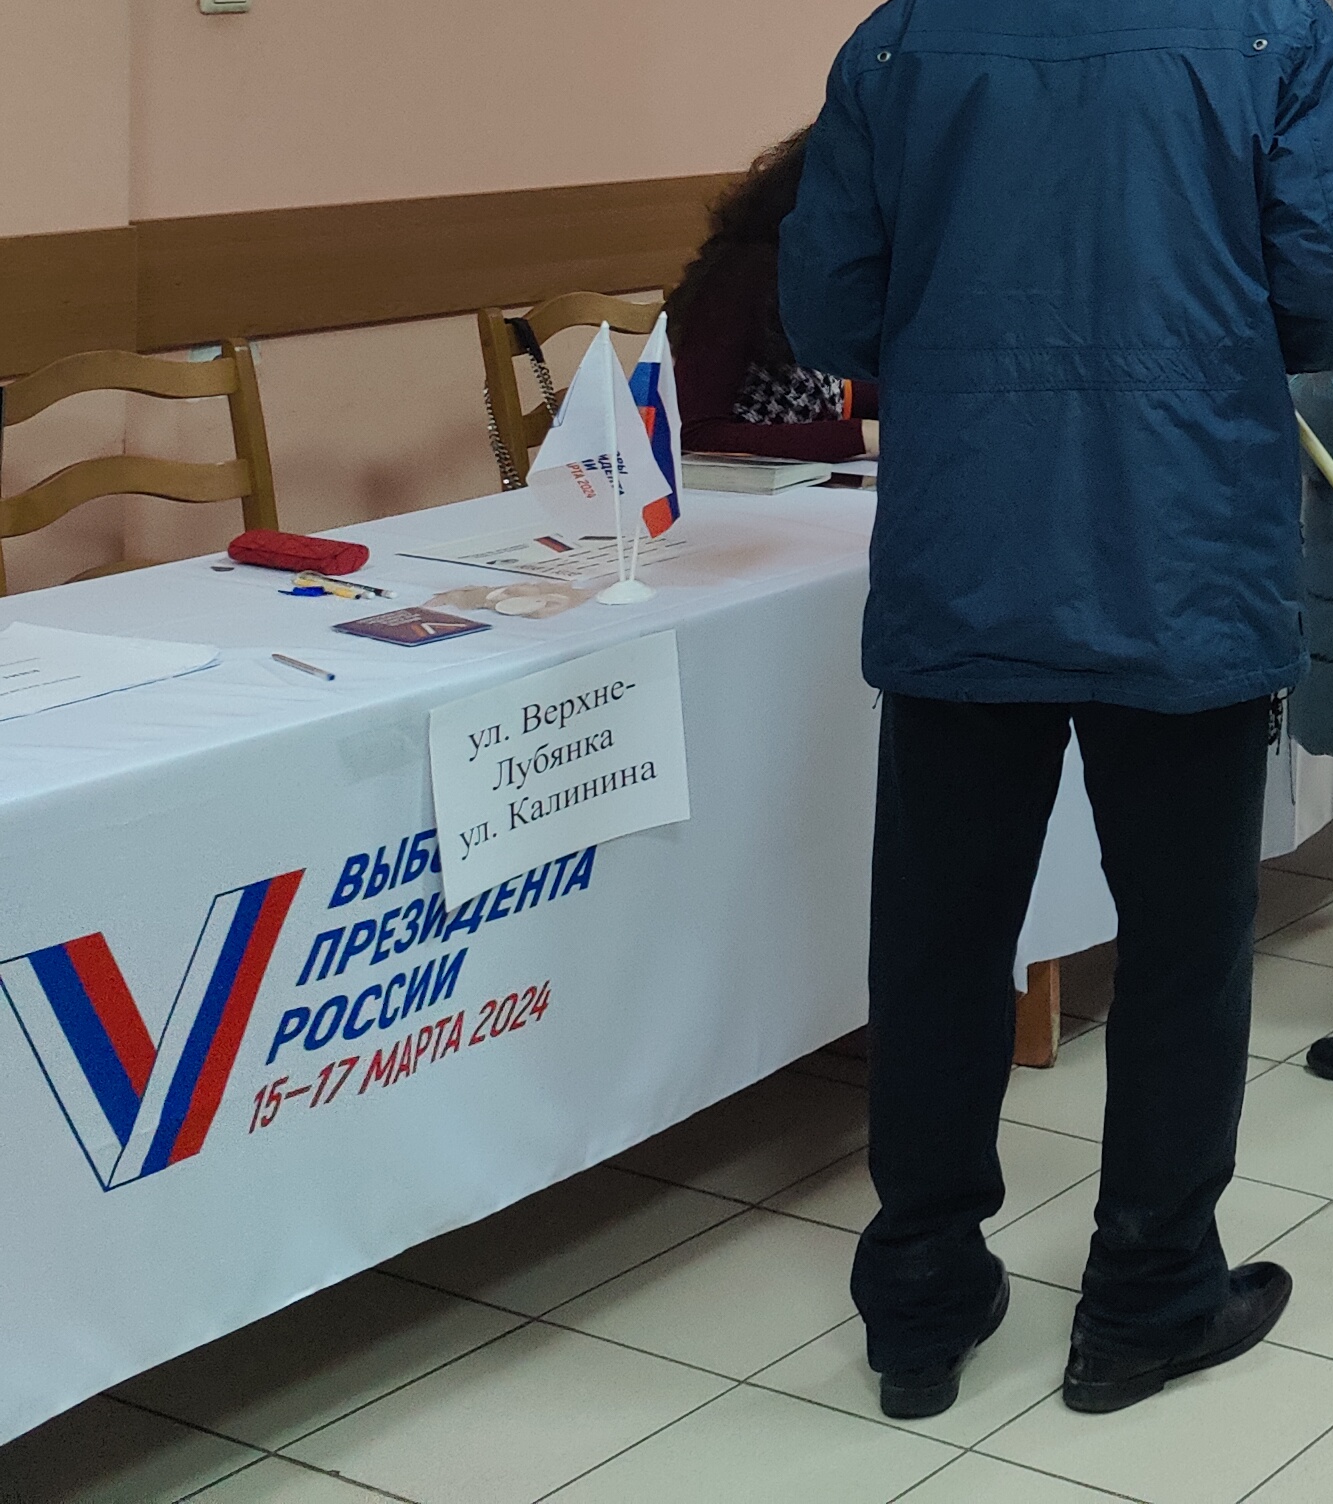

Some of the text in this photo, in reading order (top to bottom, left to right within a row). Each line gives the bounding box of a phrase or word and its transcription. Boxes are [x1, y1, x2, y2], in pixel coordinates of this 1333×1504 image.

[468, 679, 636, 762] ул. Верхне-
[492, 728, 615, 791] Лубянка
[459, 761, 658, 861] ул. Калинина
[296, 844, 598, 986] ПРЕЗИДЕНТА
[327, 828, 442, 909] ВЫБ
[265, 947, 469, 1066] РОССИИ
[358, 1010, 465, 1095] МАРТА
[468, 979, 552, 1047] 2024
